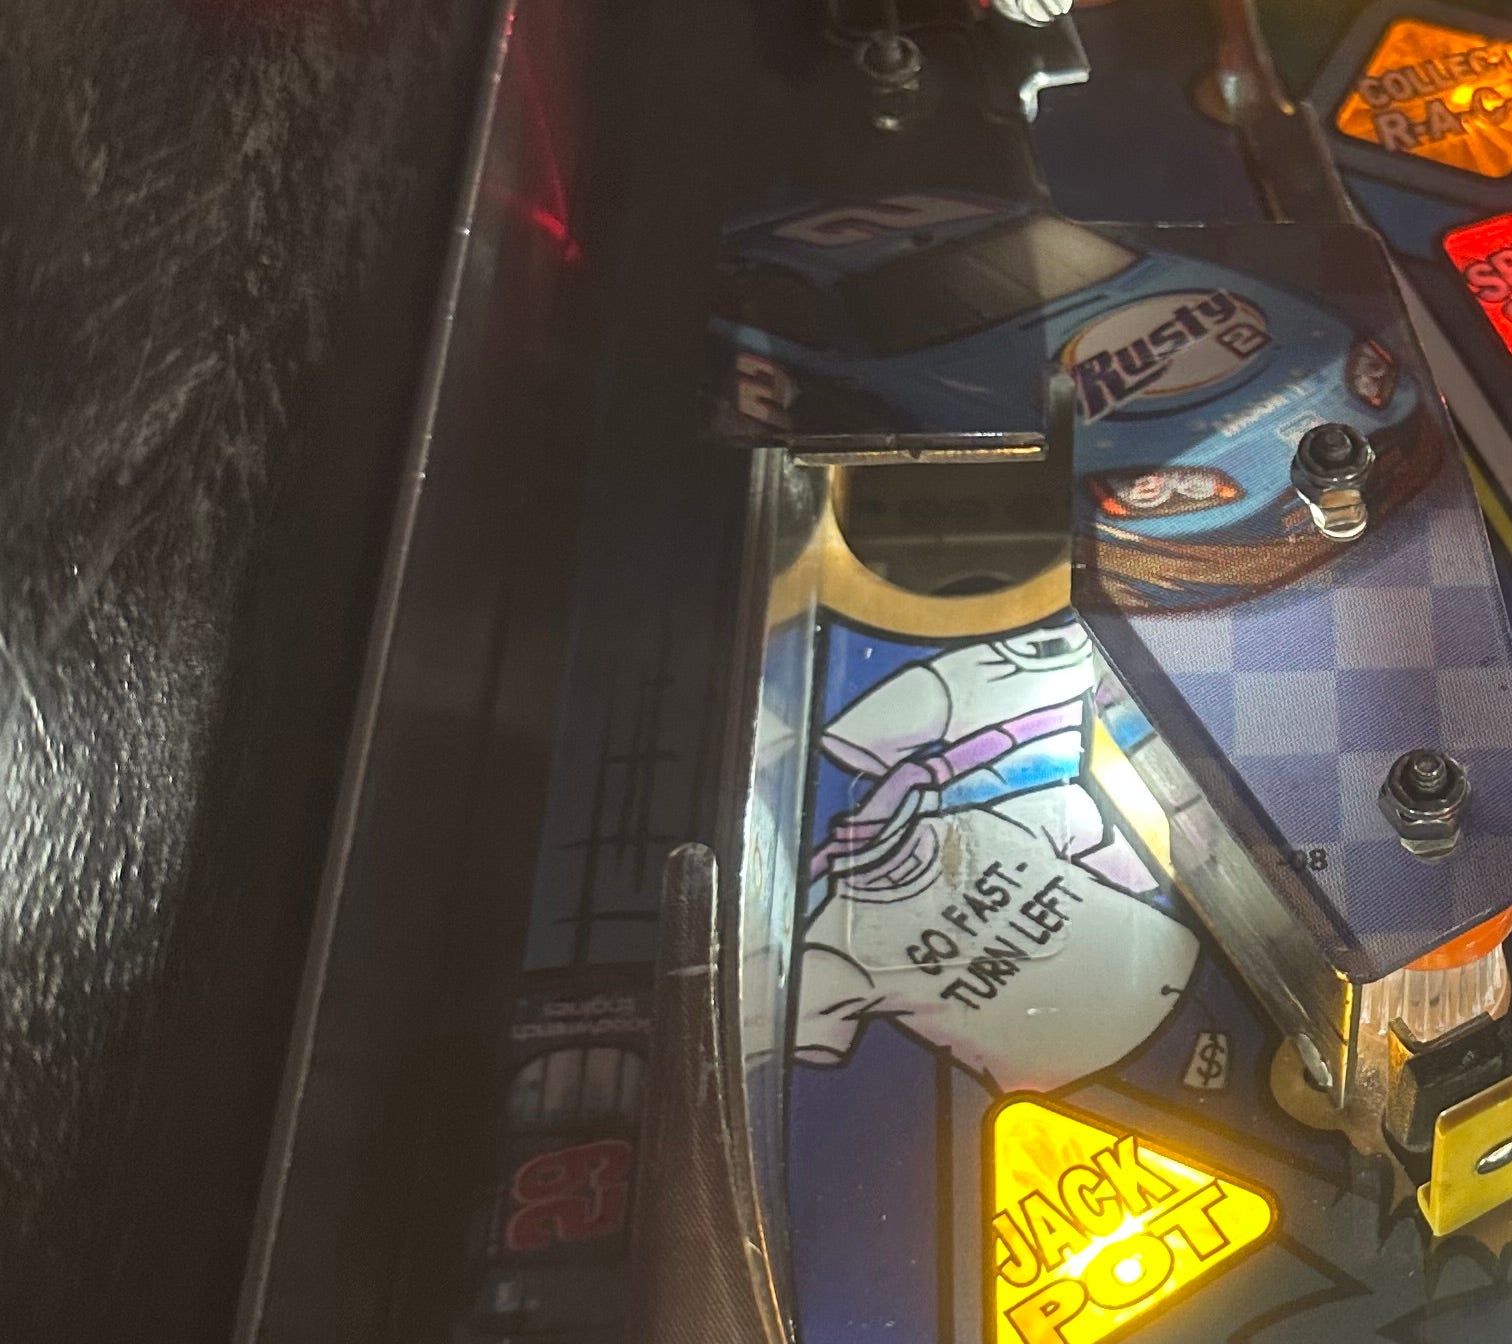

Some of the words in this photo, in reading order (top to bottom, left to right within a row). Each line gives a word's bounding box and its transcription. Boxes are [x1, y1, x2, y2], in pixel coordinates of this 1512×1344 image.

[1358, 46, 1512, 109] COLLECT
[1069, 288, 1238, 422] Rusty
[903, 918, 961, 979] GO
[941, 928, 1031, 1014] TURN
[1011, 874, 1085, 952] LEFT
[992, 1133, 1178, 1288] JACK
